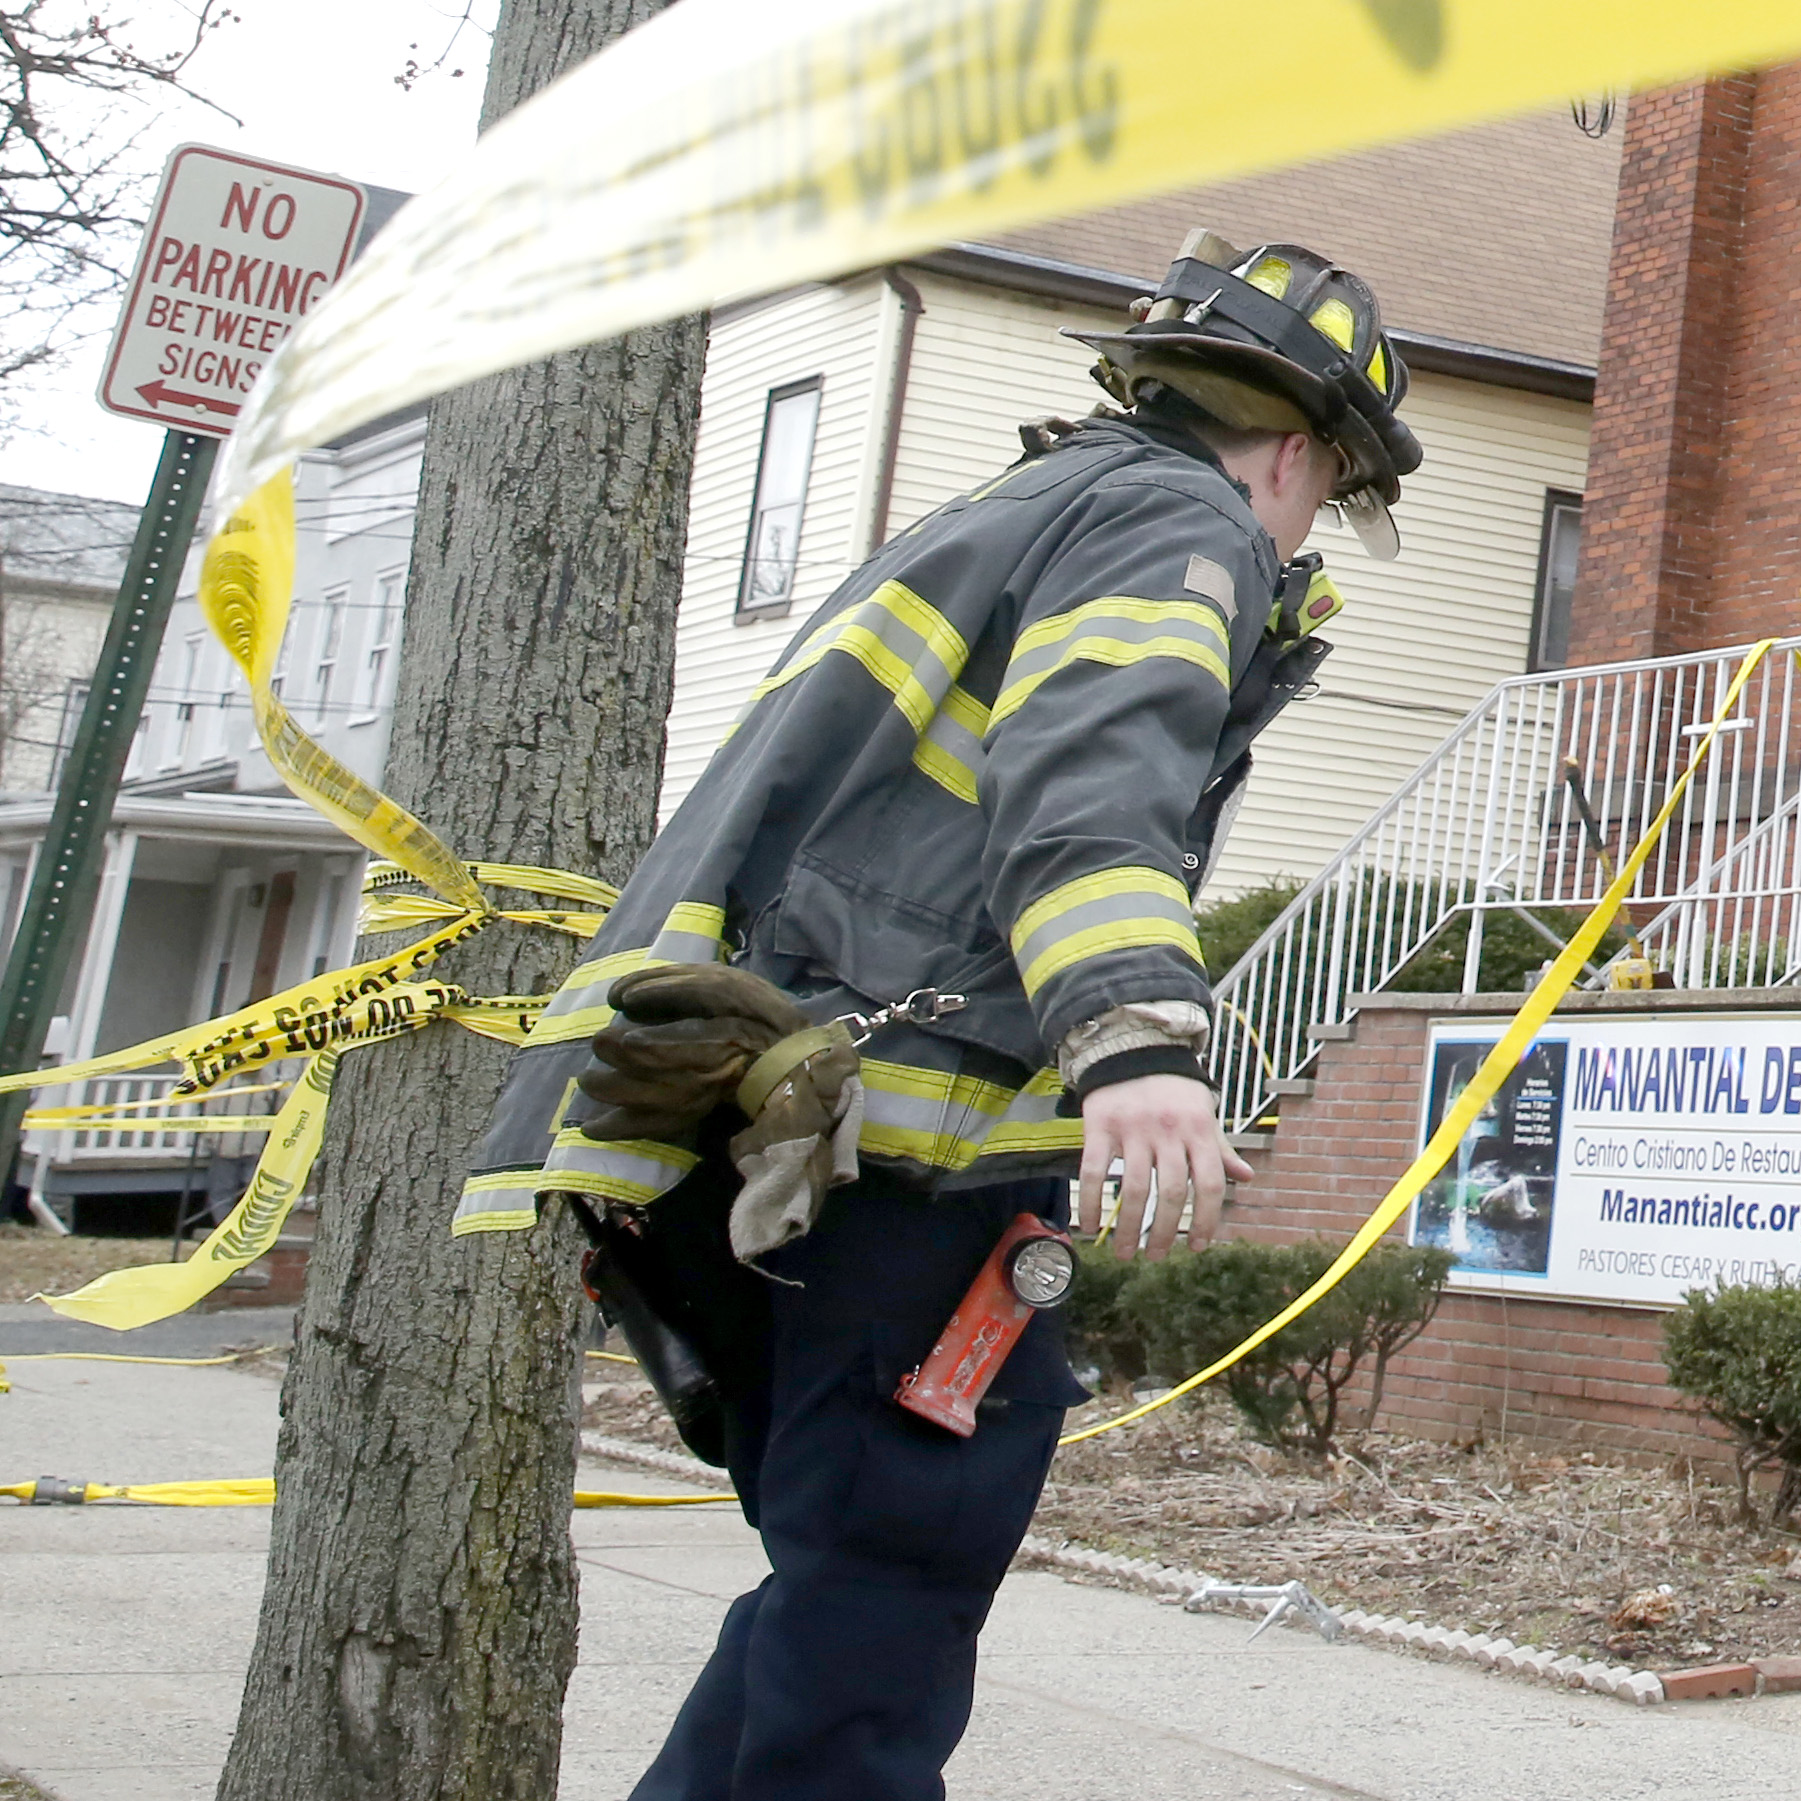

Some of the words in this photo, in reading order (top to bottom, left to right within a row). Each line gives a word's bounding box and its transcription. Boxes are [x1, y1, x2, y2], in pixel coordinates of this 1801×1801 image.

[220, 182, 296, 240] NO
[152, 237, 327, 316] PARKING
[159, 343, 262, 394] SIGNS
[1573, 1046, 1749, 1114] MANANTIAL
[1574, 1136, 1628, 1167] Centro
[1633, 1138, 1708, 1172] Cristiano
[1712, 1141, 1735, 1172] De
[1578, 1248, 1657, 1277] PASTORES
[1661, 1254, 1712, 1280] CESAR
[1716, 1259, 1727, 1278] Y
[1730, 1259, 1778, 1284] RUTH
